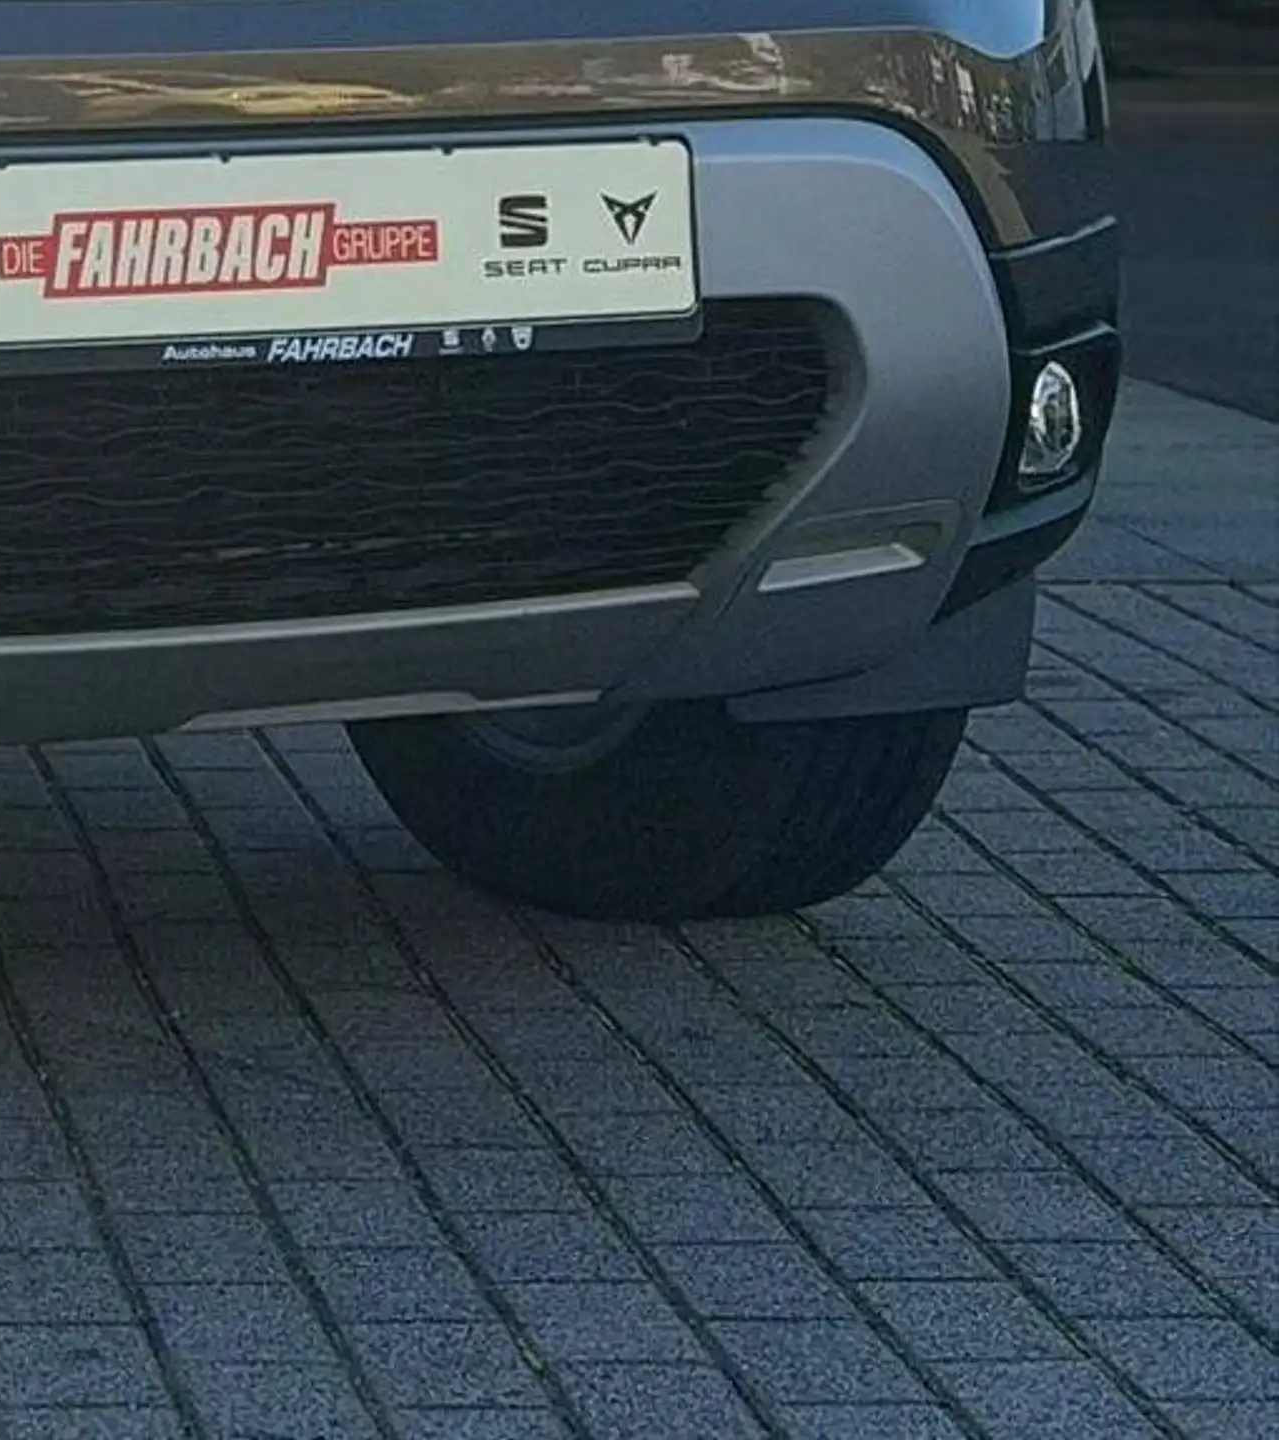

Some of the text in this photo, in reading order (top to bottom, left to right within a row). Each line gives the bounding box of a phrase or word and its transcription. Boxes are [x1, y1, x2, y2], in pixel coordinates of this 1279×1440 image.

[1, 210, 434, 291] DIE FAHRBACH GRUPPE
[483, 256, 682, 278] SEAT CUPRA
[161, 332, 415, 363] Autohaus FAHRBACH
